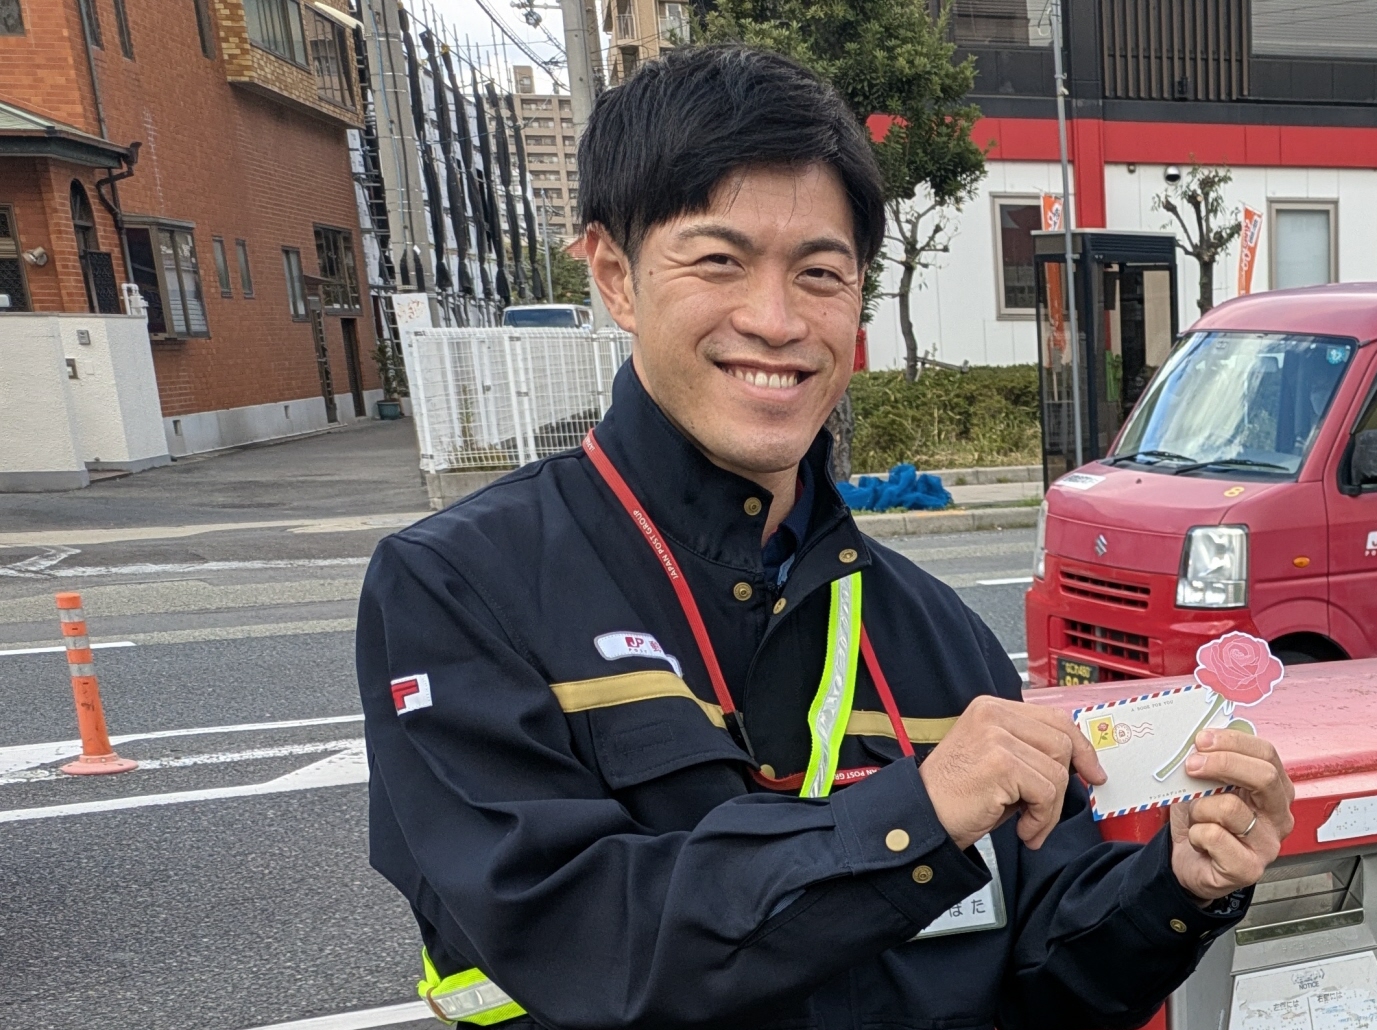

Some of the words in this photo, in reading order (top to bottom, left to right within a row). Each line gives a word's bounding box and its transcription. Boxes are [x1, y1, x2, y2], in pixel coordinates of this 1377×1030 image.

[632, 510, 653, 536] GROUP
[649, 534, 665, 555] POST
[662, 554, 679, 580] JAPAN
[846, 771, 866, 779] POST
[1298, 980, 1320, 990] NOTICE
